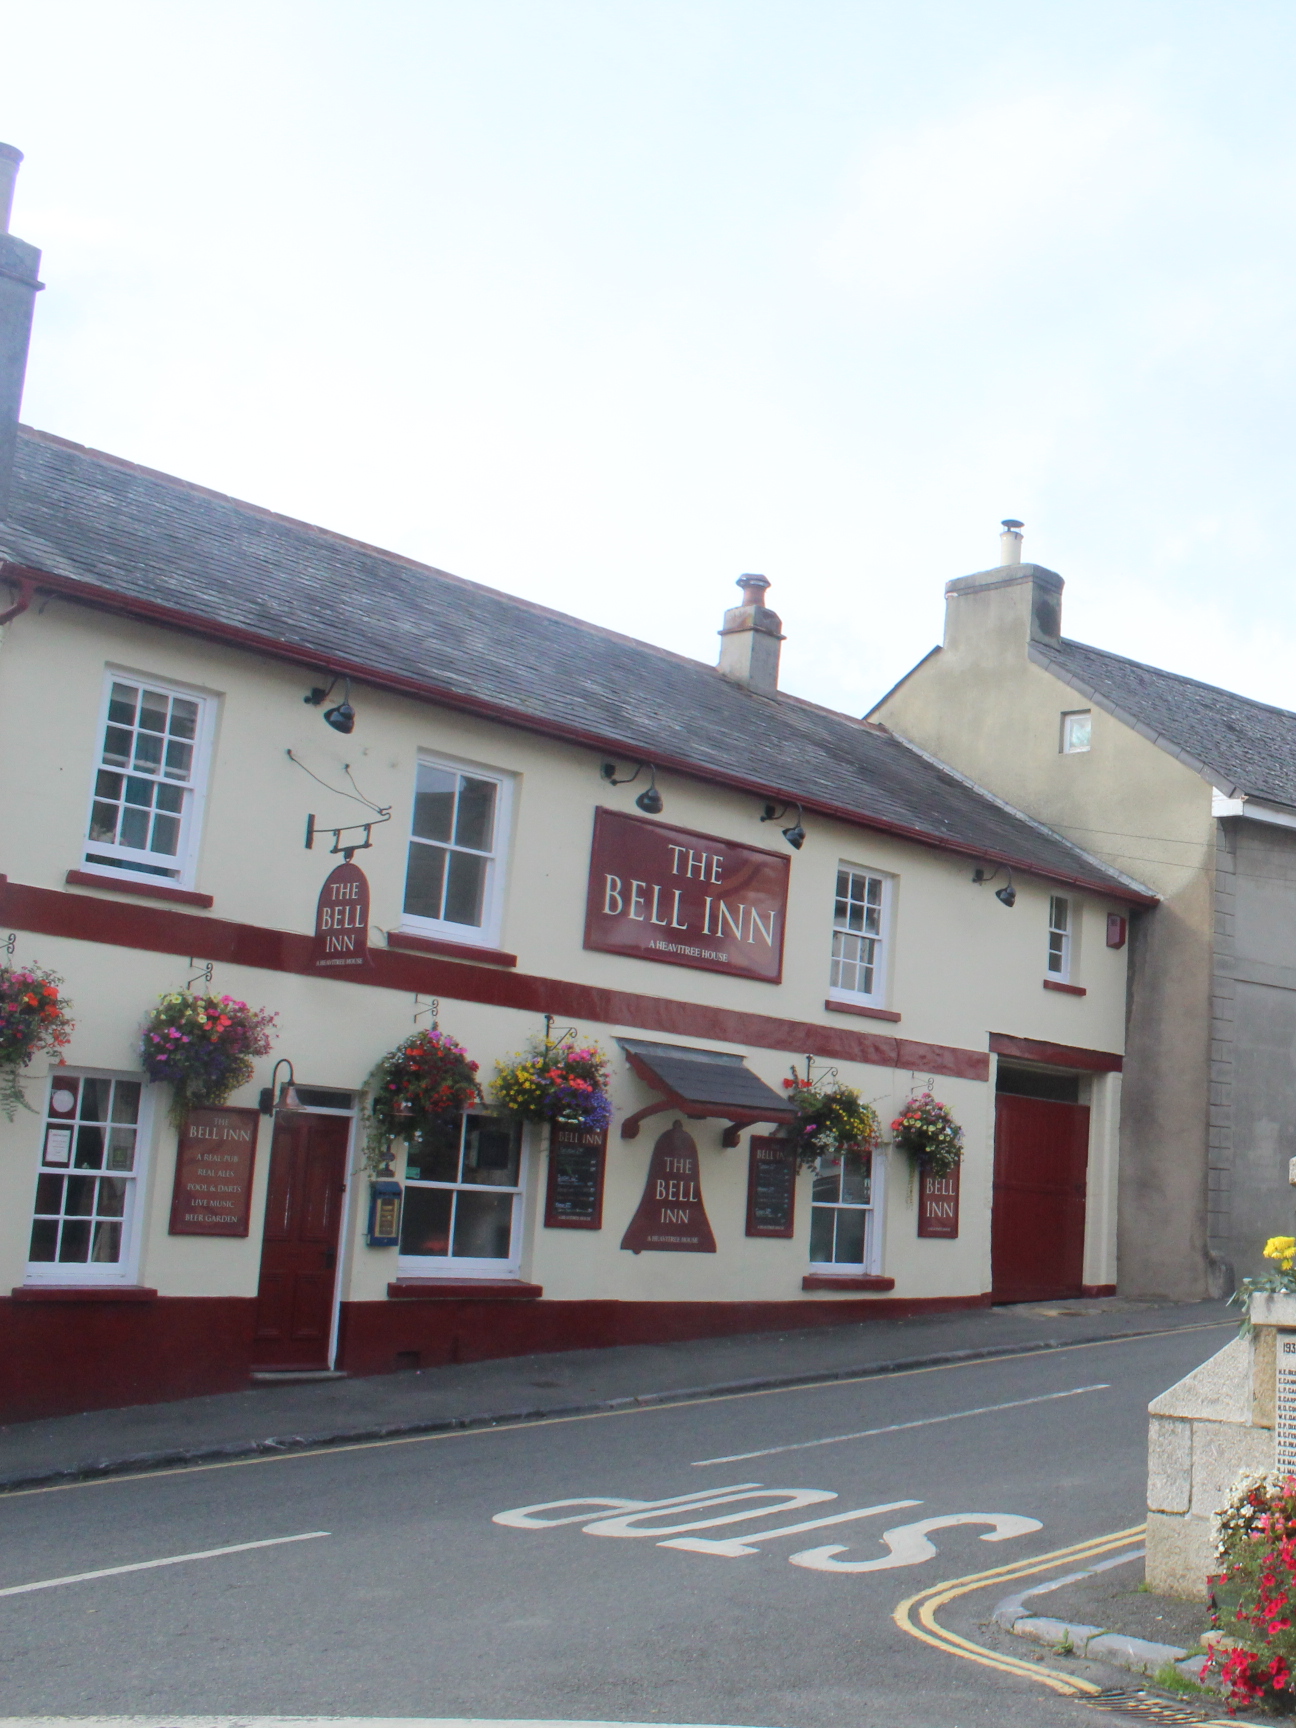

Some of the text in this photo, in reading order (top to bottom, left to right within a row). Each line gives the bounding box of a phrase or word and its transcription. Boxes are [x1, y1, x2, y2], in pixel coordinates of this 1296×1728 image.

[668, 844, 724, 885] THE
[330, 882, 360, 900] THE
[321, 905, 365, 930] BELL
[602, 873, 776, 947] BELL INN
[325, 935, 355, 952] INN
[648, 940, 728, 962] A HEAVITREE HOUSE
[189, 1126, 250, 1142] BELL INN
[558, 1132, 602, 1144] BELL INN
[204, 1154, 221, 1162] REAL
[756, 1149, 774, 1160] BELL
[664, 1157, 692, 1174] THE
[218, 1185, 241, 1193] DARTS
[656, 1179, 698, 1202] BELL
[926, 1178, 956, 1196] BELL
[210, 1200, 234, 1208] MUSIC
[926, 1201, 954, 1218] INN
[660, 1208, 689, 1224] INN
[680, 1236, 699, 1244] HOUSE
[492, 1482, 1044, 1573] SLOW
